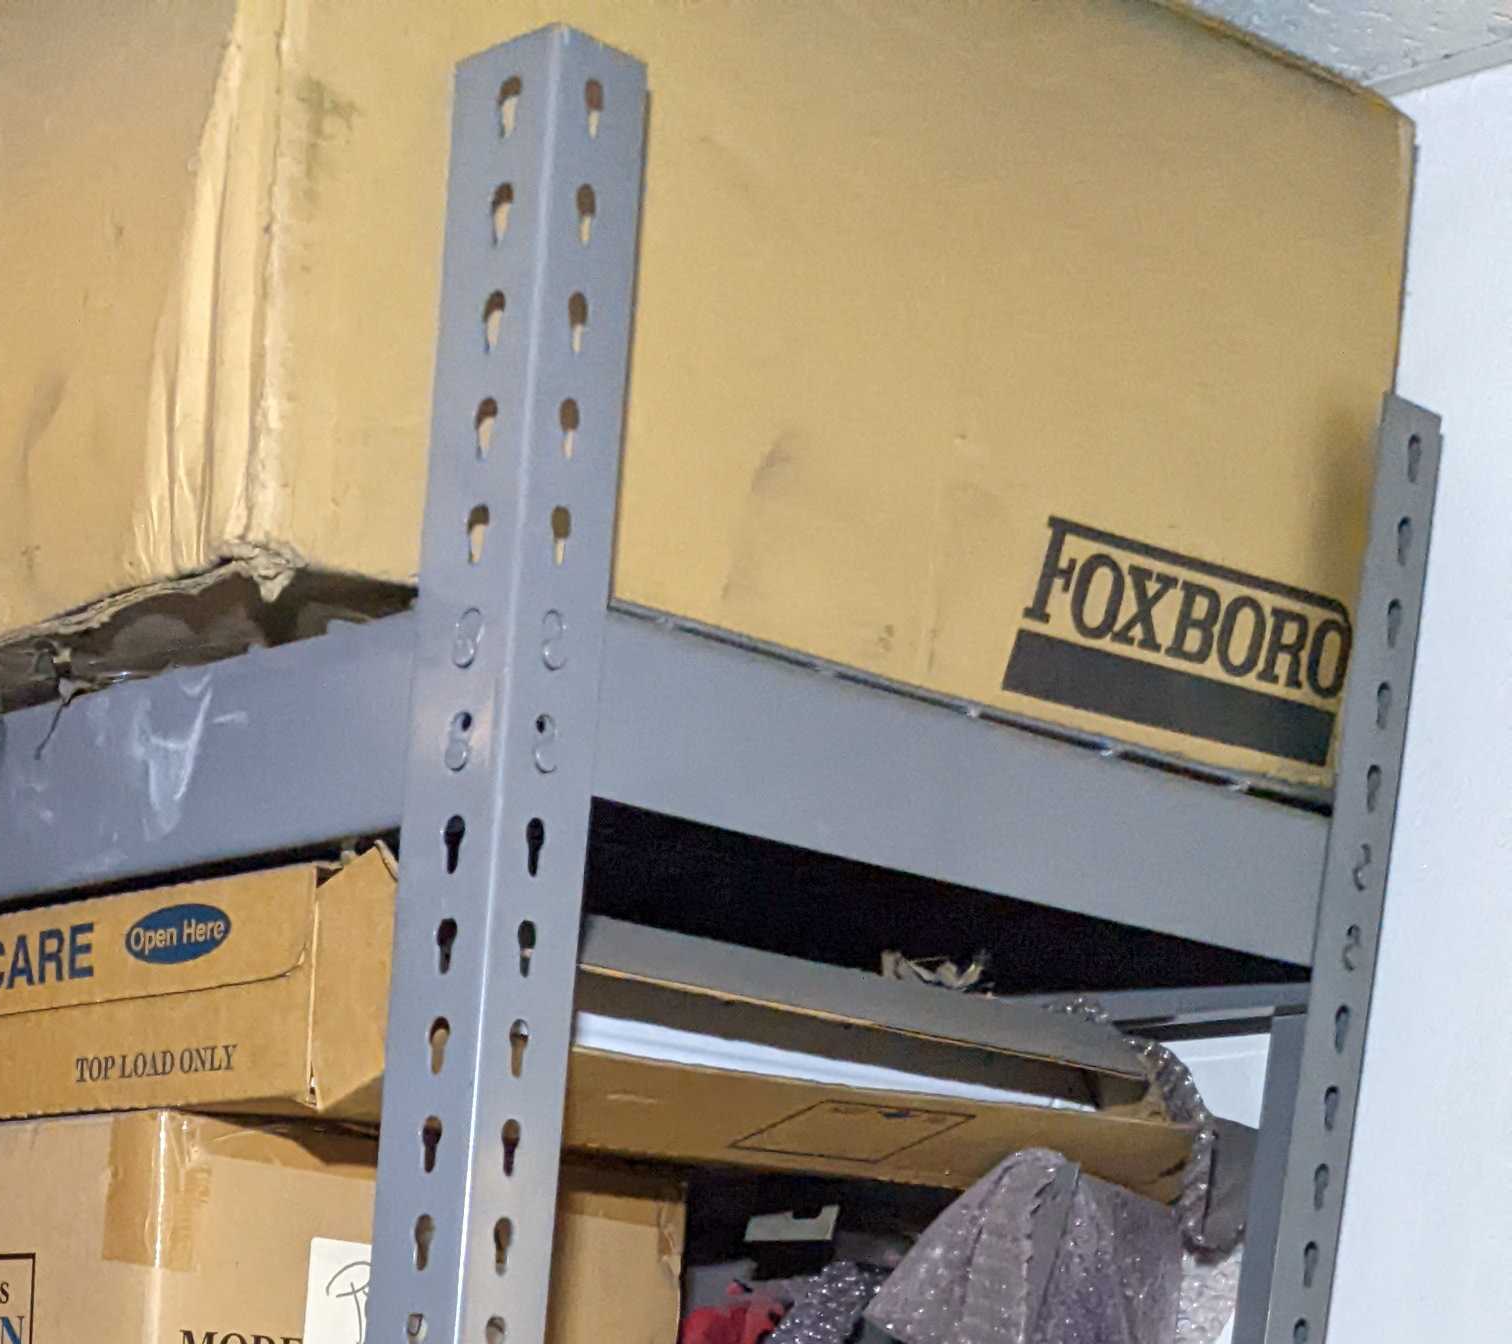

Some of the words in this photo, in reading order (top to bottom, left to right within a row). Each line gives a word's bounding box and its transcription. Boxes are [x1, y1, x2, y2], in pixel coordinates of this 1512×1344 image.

[1021, 514, 1353, 699] FOXBORO
[129, 927, 177, 956] Open
[182, 918, 225, 945] Here
[76, 1055, 113, 1082] TOP
[119, 1050, 175, 1080] LOAD
[179, 1043, 238, 1075] ONLY
